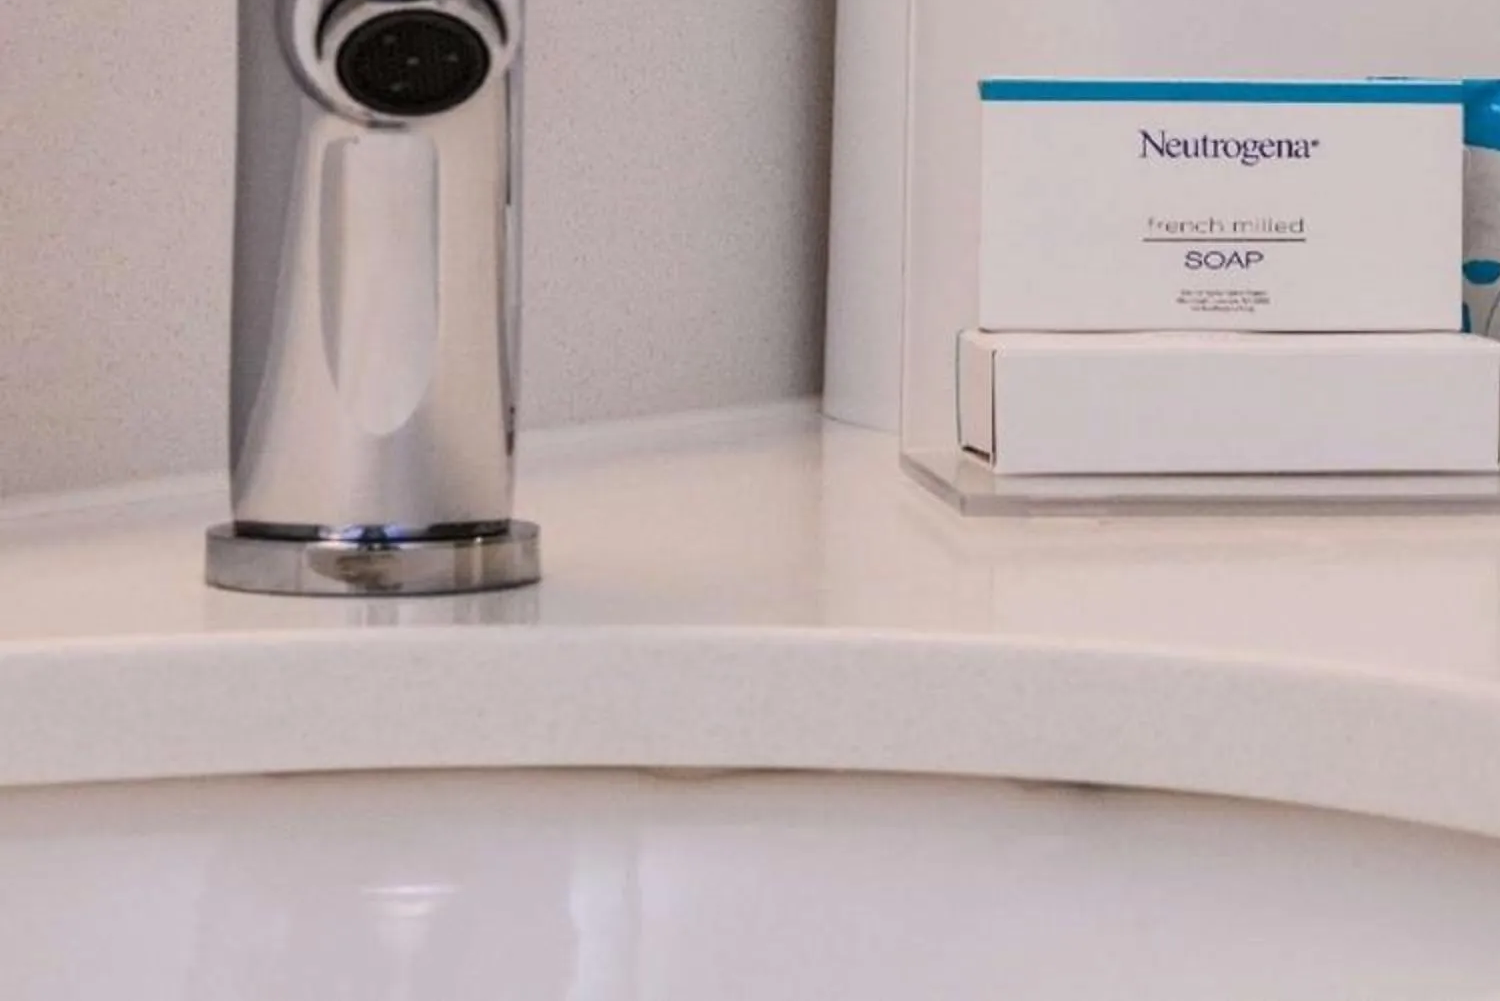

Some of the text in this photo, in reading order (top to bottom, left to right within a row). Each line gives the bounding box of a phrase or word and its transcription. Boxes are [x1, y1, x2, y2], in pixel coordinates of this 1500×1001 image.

[1139, 129, 1310, 166] Neutrogena
[1148, 216, 1306, 234] french milled
[1184, 250, 1264, 270] SOAP
